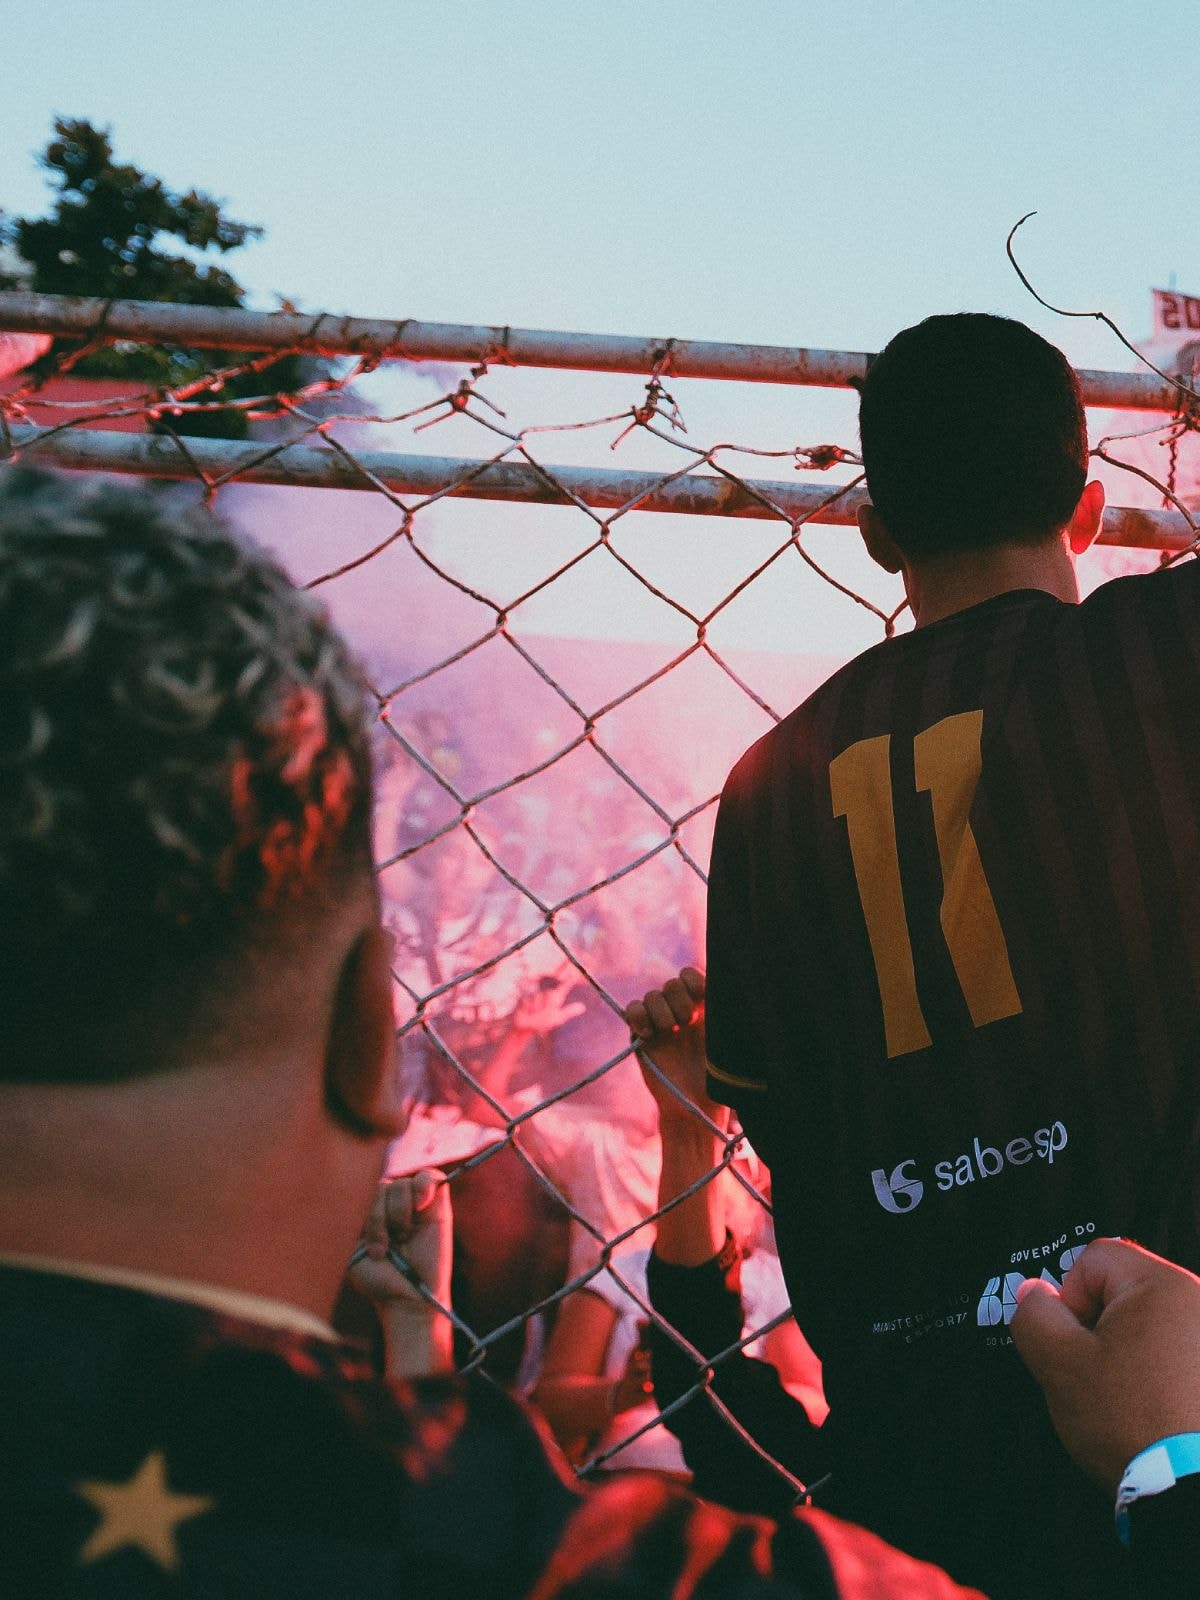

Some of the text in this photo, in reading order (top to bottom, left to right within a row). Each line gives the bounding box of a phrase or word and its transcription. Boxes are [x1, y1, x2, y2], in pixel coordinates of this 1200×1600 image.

[829, 709, 1023, 1059] 11
[935, 1120, 1068, 1192] sabesp
[1010, 1222, 1096, 1263] GOVERNO DO
